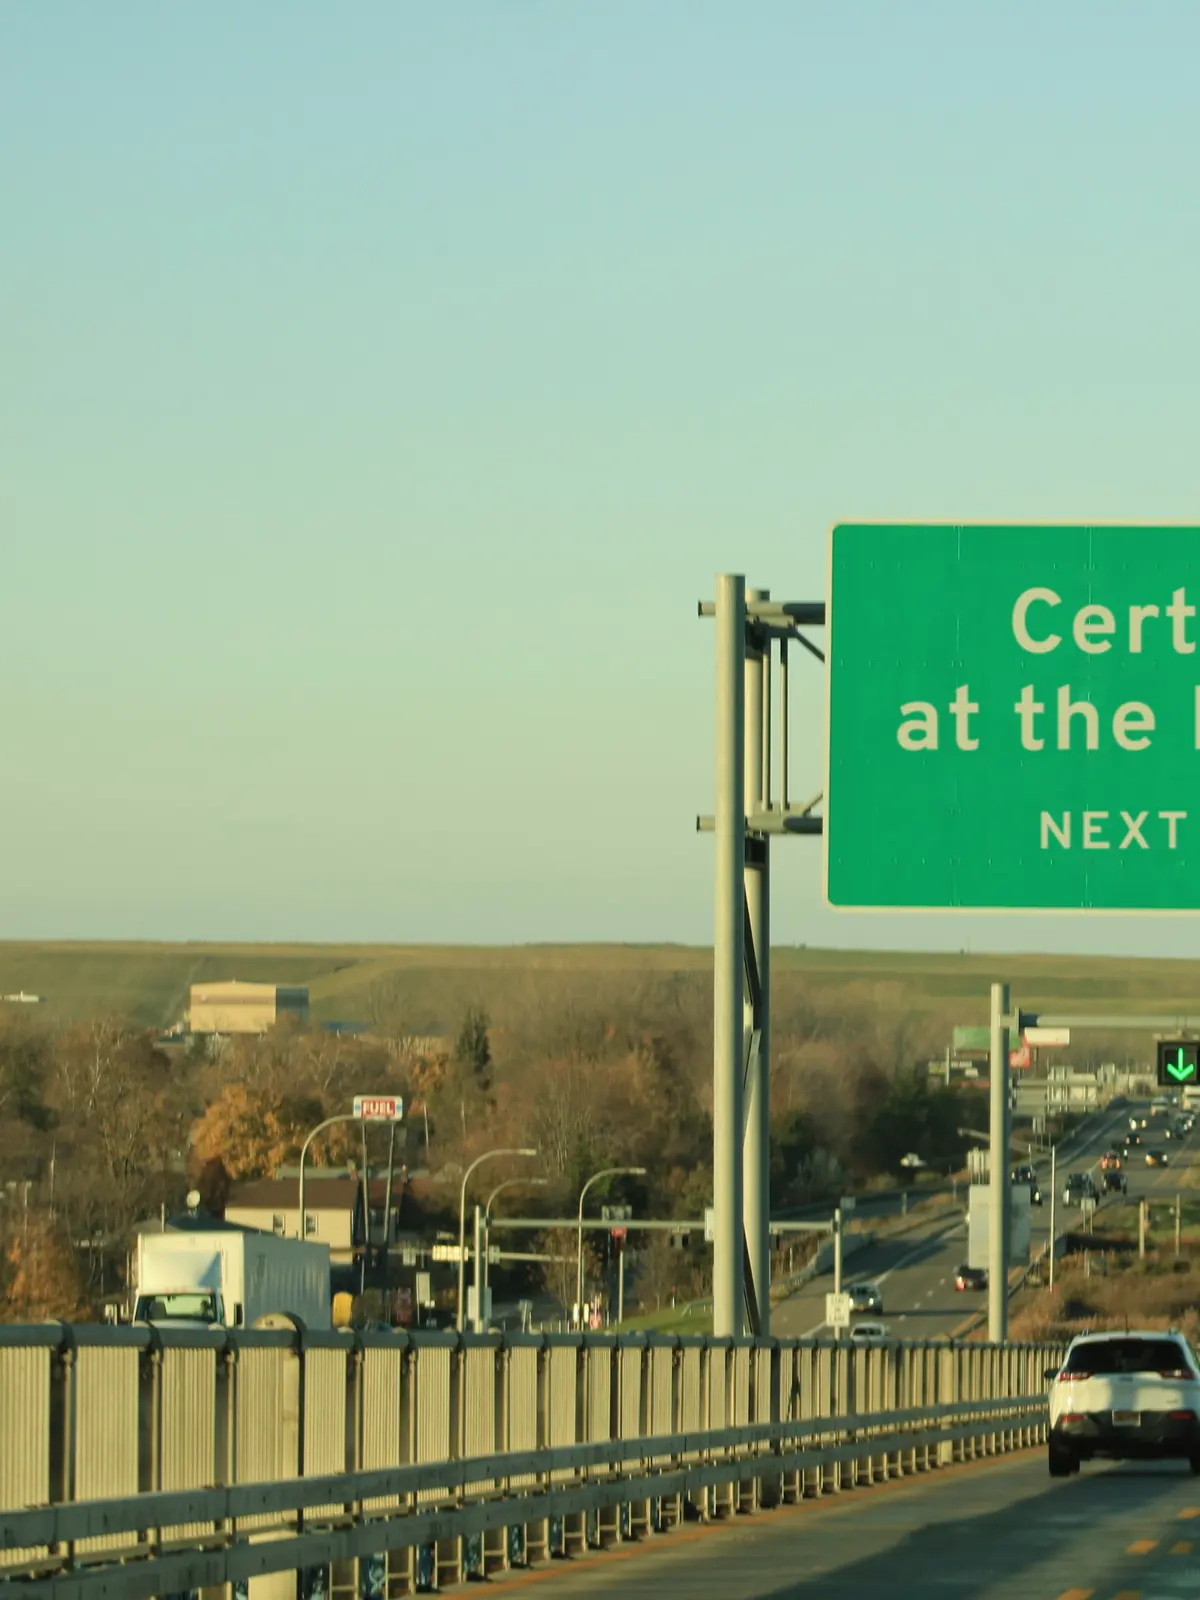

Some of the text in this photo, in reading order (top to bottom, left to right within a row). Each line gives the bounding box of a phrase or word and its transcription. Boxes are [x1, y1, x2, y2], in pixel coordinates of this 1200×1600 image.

[896, 684, 979, 751] at
[1015, 684, 1156, 751] the
[1040, 811, 1188, 849] NEXT
[362, 1100, 394, 1118] FUEL
